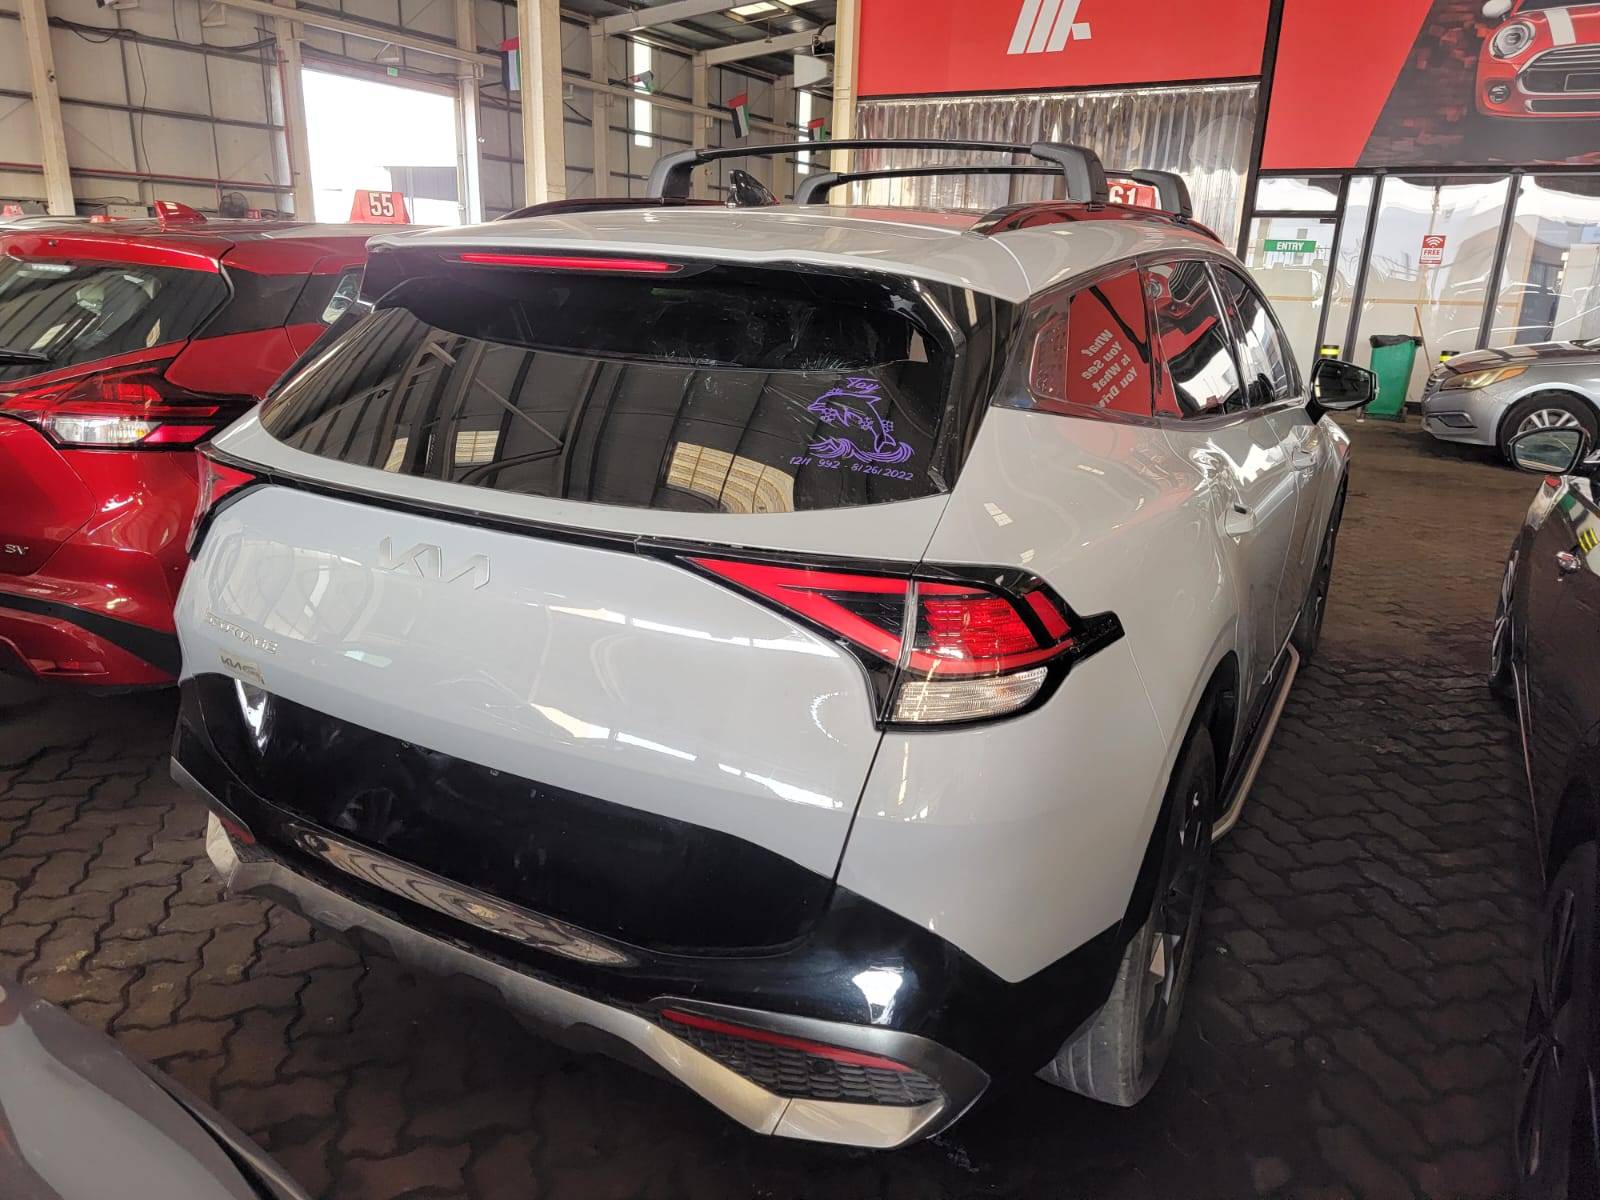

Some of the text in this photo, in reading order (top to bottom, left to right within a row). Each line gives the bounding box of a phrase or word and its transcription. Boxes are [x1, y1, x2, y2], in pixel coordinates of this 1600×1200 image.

[368, 192, 395, 217] 55
[1109, 185, 1136, 205] 61
[1276, 241, 1305, 251] ENTRY
[4, 544, 29, 555] SV
[376, 536, 490, 590] KIA
